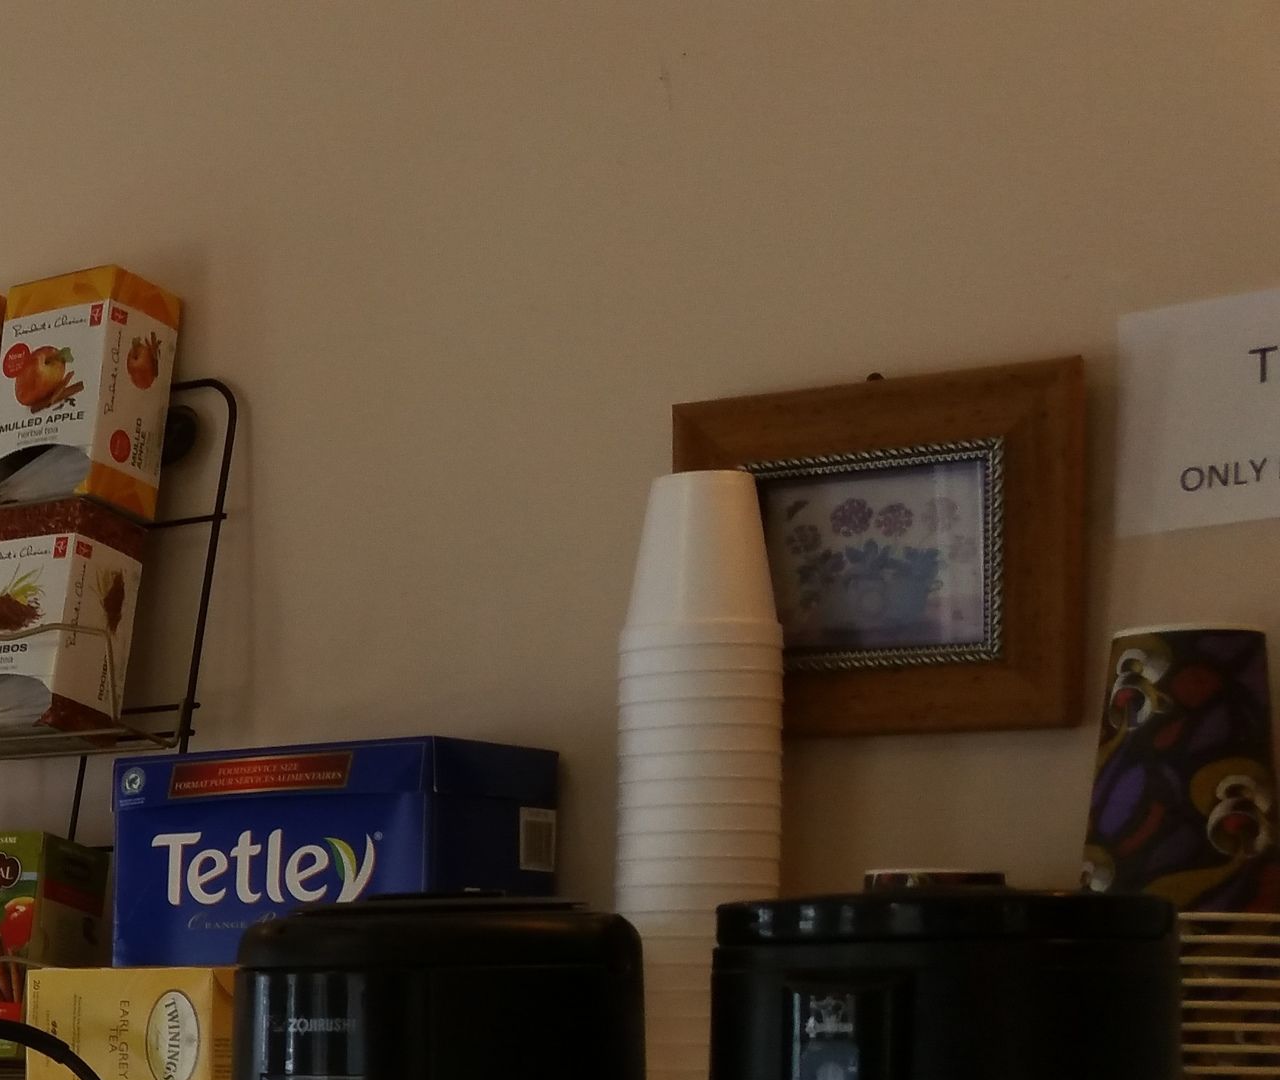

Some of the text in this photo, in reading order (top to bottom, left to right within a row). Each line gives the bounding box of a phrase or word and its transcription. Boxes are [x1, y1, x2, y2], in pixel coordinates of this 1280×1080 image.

[0, 410, 85, 434] MULLED APPLE
[1180, 457, 1268, 492] ONLY
[174, 770, 344, 791] FORMAT POUR SERVICES ALIMENTAIRES
[218, 764, 277, 776] FOODSERVICE
[151, 828, 377, 906] Tetley
[108, 1027, 120, 1054] TEA
[118, 1000, 130, 1080] EARL GREY
